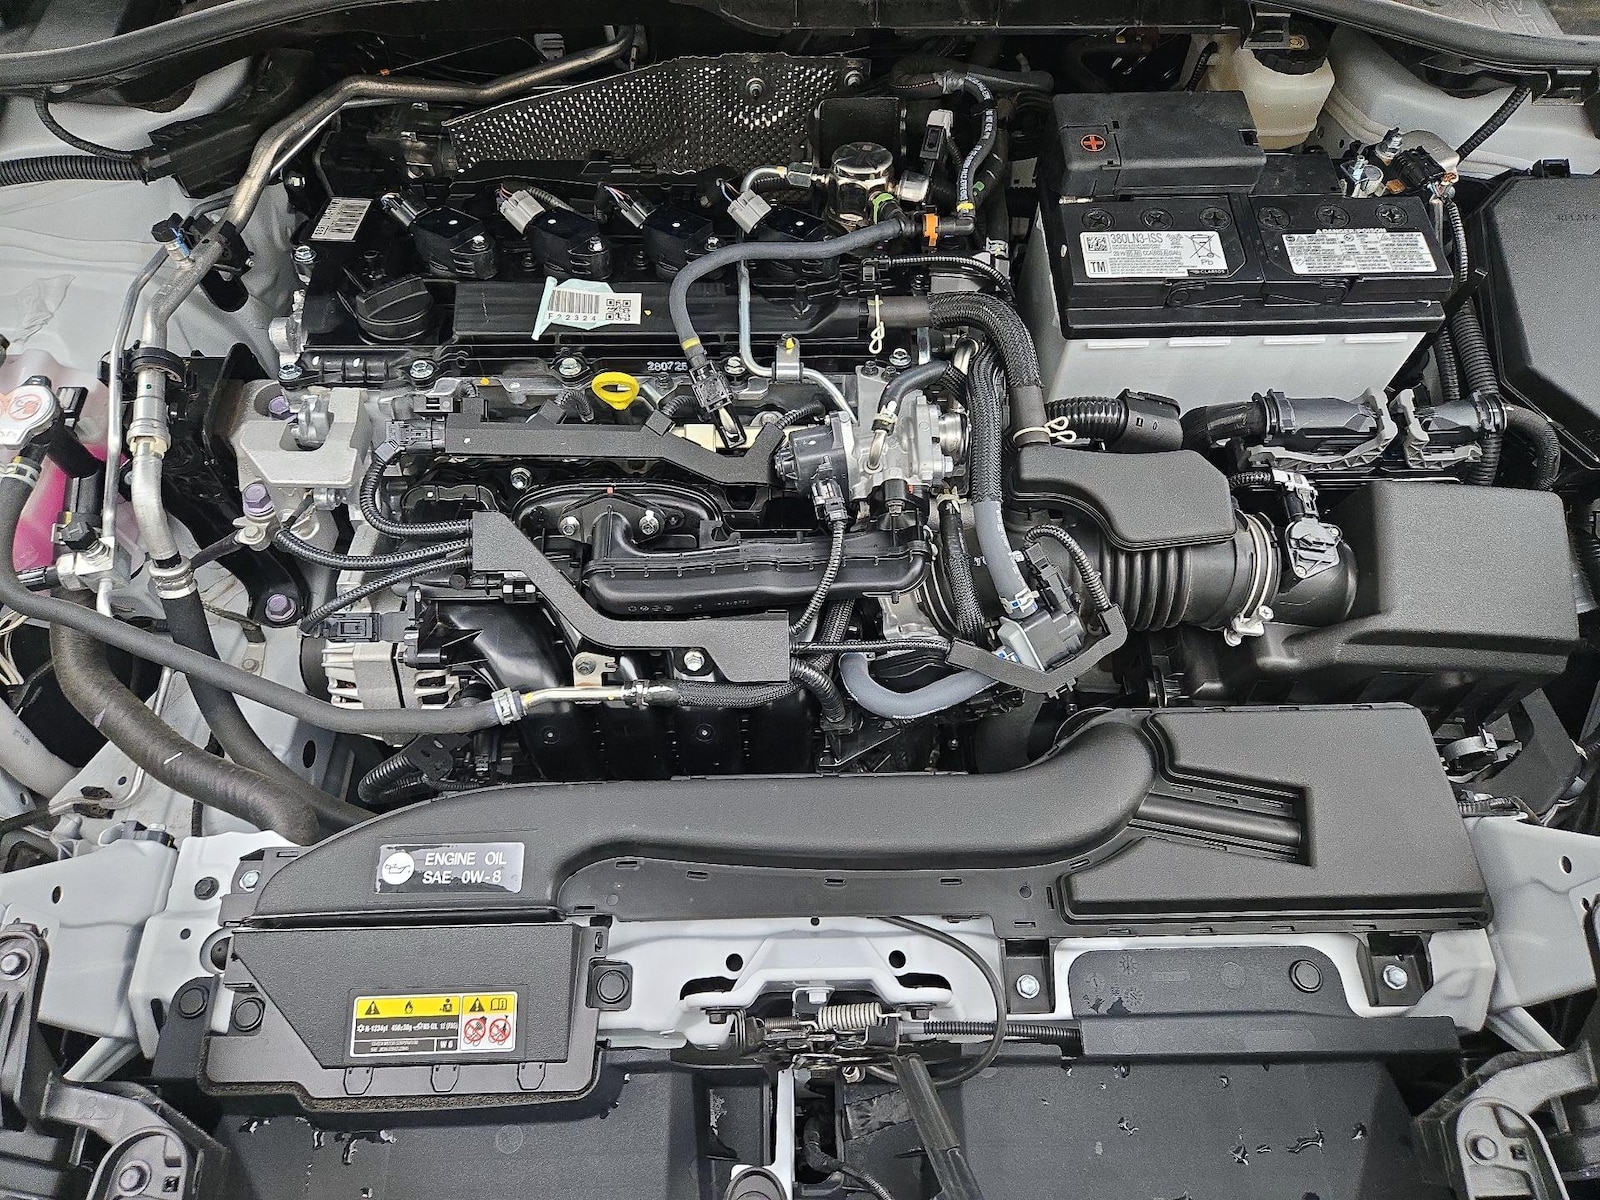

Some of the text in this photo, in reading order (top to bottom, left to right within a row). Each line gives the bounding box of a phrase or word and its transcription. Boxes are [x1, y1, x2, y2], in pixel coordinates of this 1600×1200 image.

[1110, 233, 1163, 244] 380LN3-ISS
[1090, 261, 1106, 273] TM
[424, 851, 507, 866] ENGINE OIL
[422, 870, 452, 884] SAE
